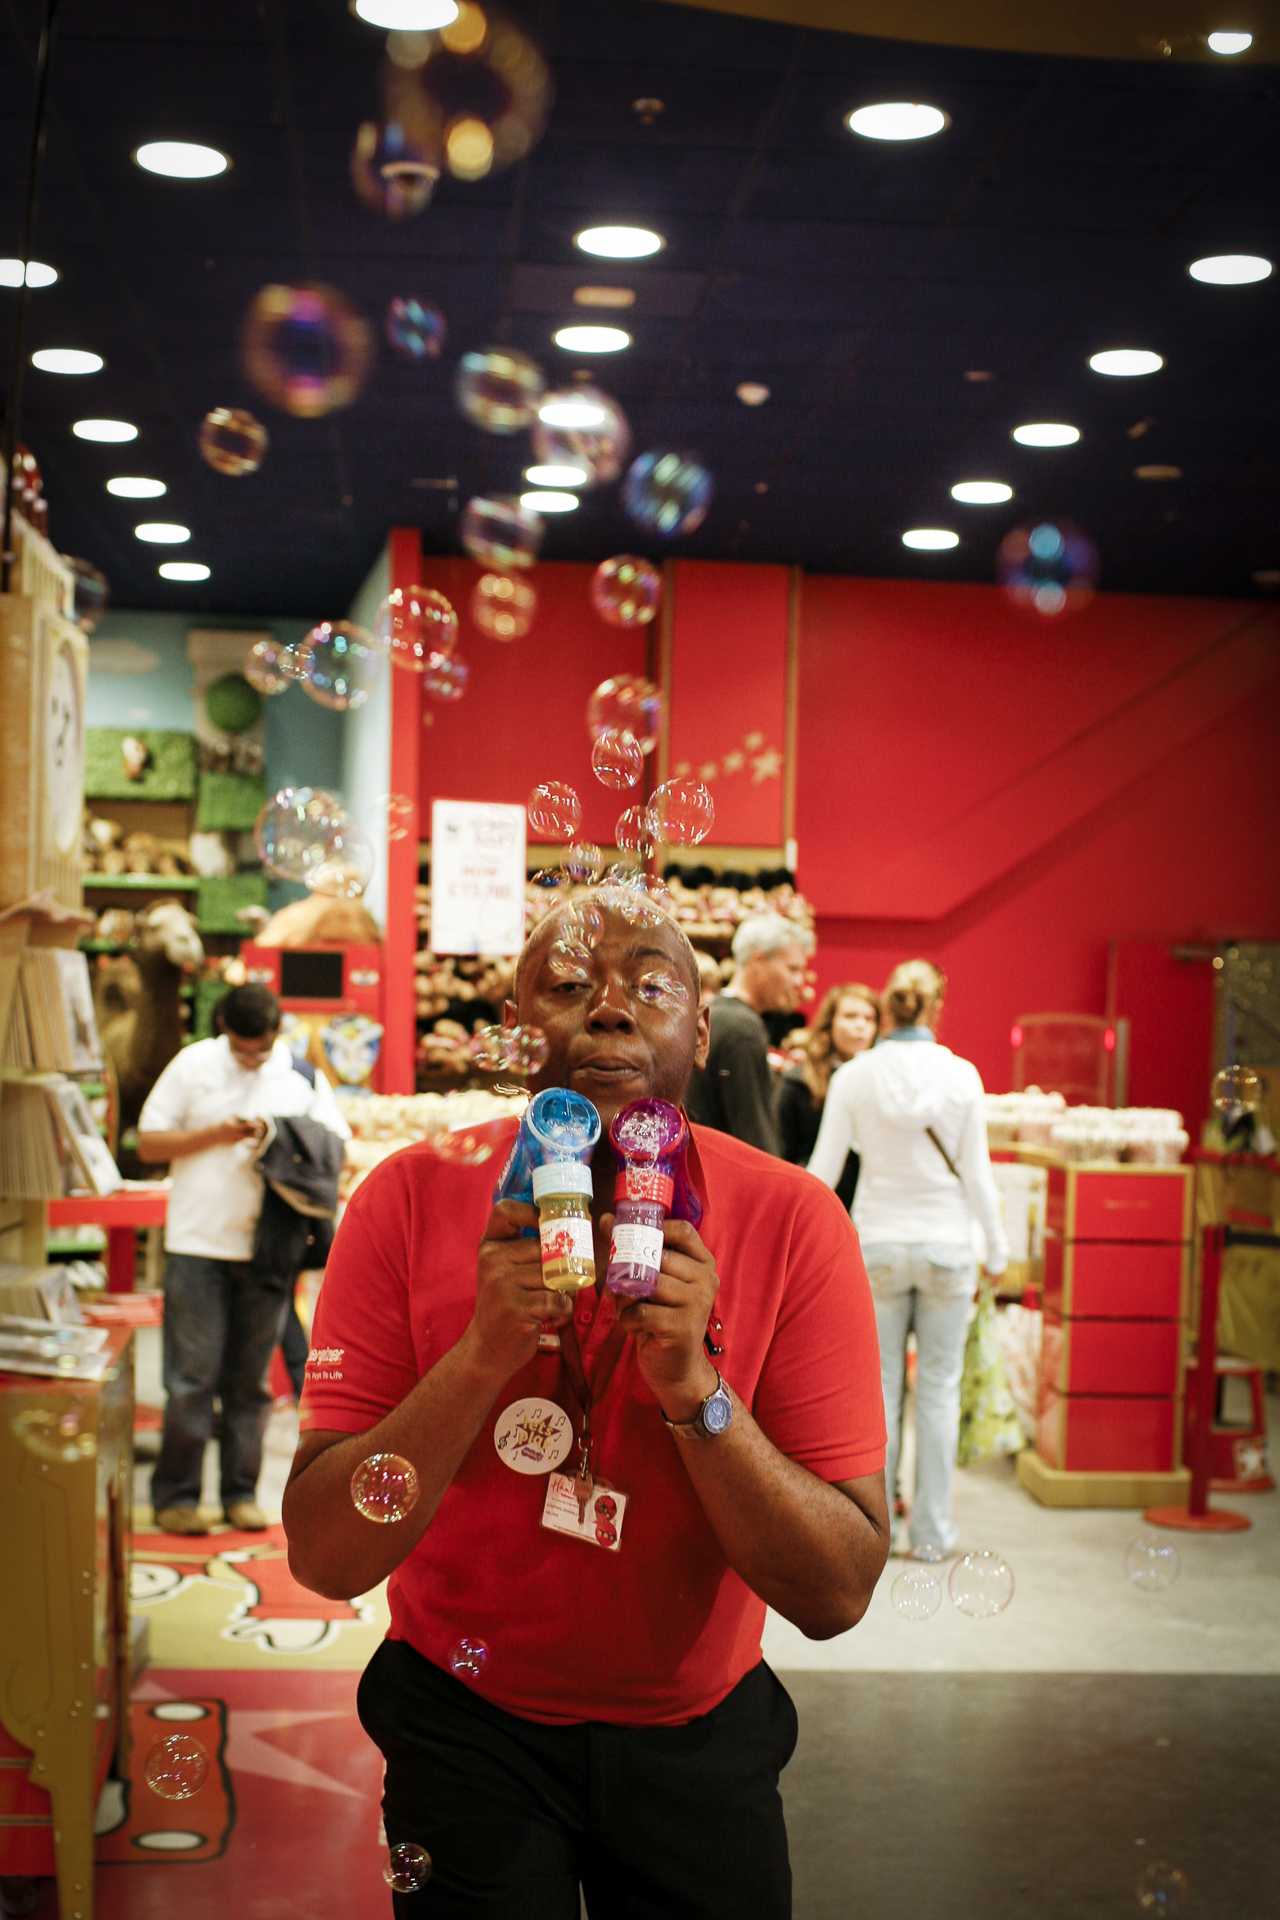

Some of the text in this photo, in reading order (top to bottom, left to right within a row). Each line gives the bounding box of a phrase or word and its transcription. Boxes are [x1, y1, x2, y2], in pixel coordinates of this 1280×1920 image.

[308, 1346, 345, 1366] ergizer
[329, 1370, 343, 1380] Life
[523, 1414, 554, 1435] lets
[517, 1430, 552, 1451] play
[552, 1477, 576, 1495] Haml
